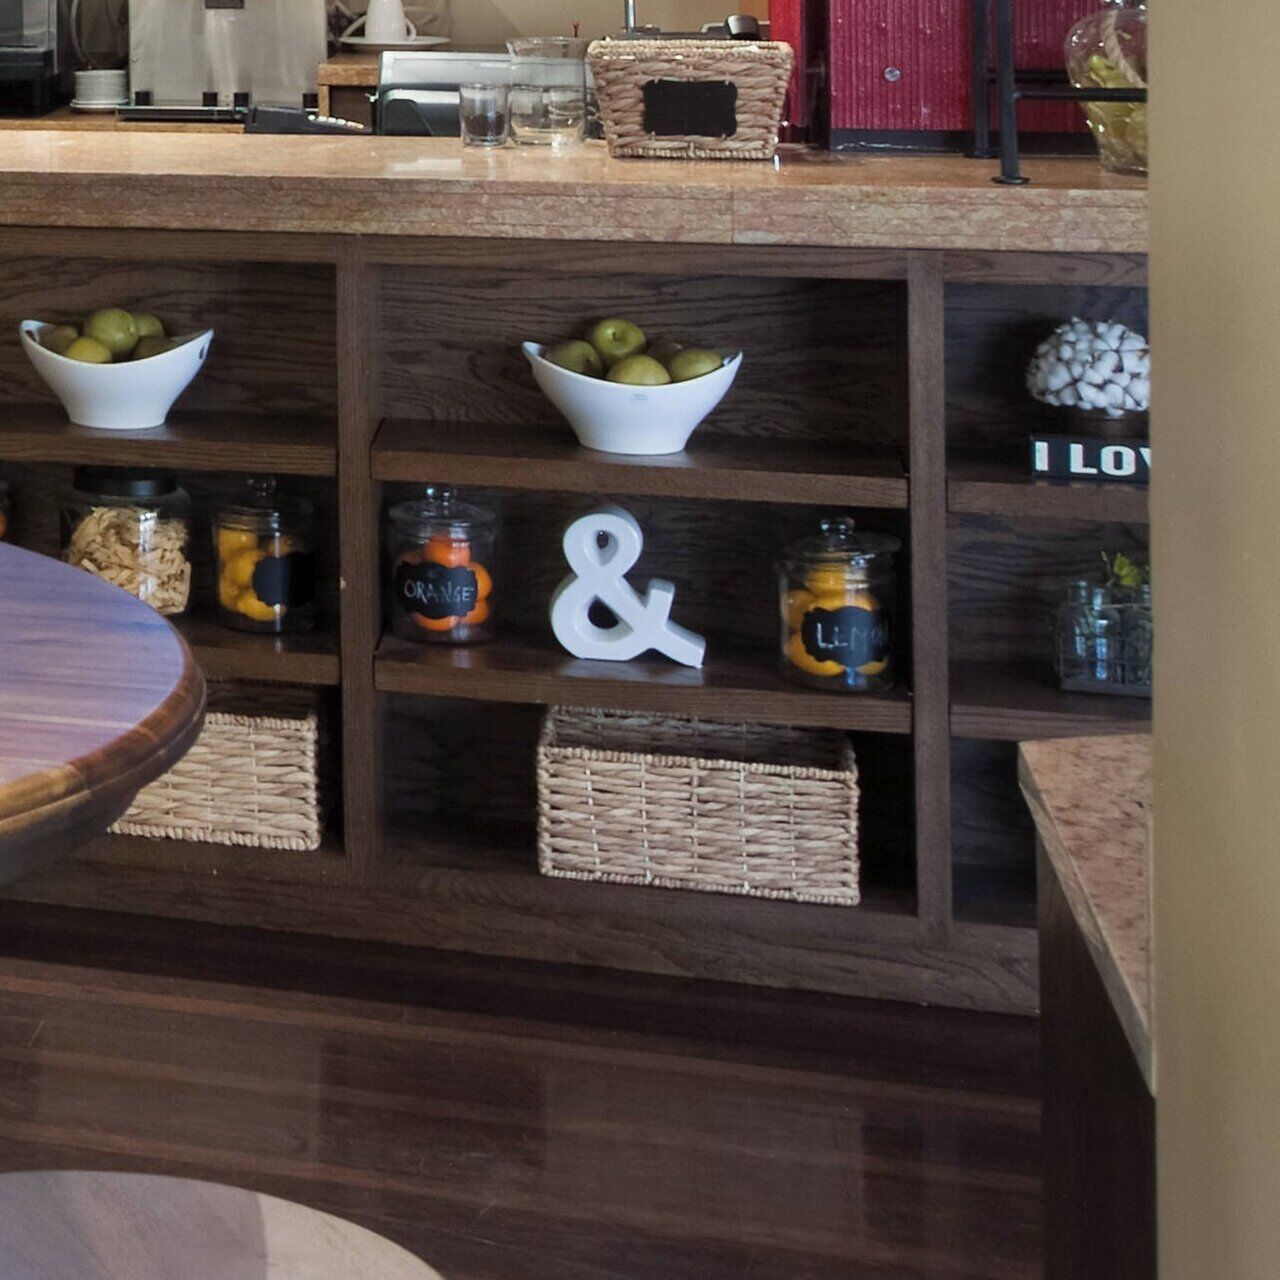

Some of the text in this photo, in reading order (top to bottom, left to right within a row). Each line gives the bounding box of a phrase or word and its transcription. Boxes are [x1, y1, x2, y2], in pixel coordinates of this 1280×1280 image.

[1035, 441, 1049, 472] I
[404, 579, 474, 605] ORANGE
[551, 505, 706, 669] &
